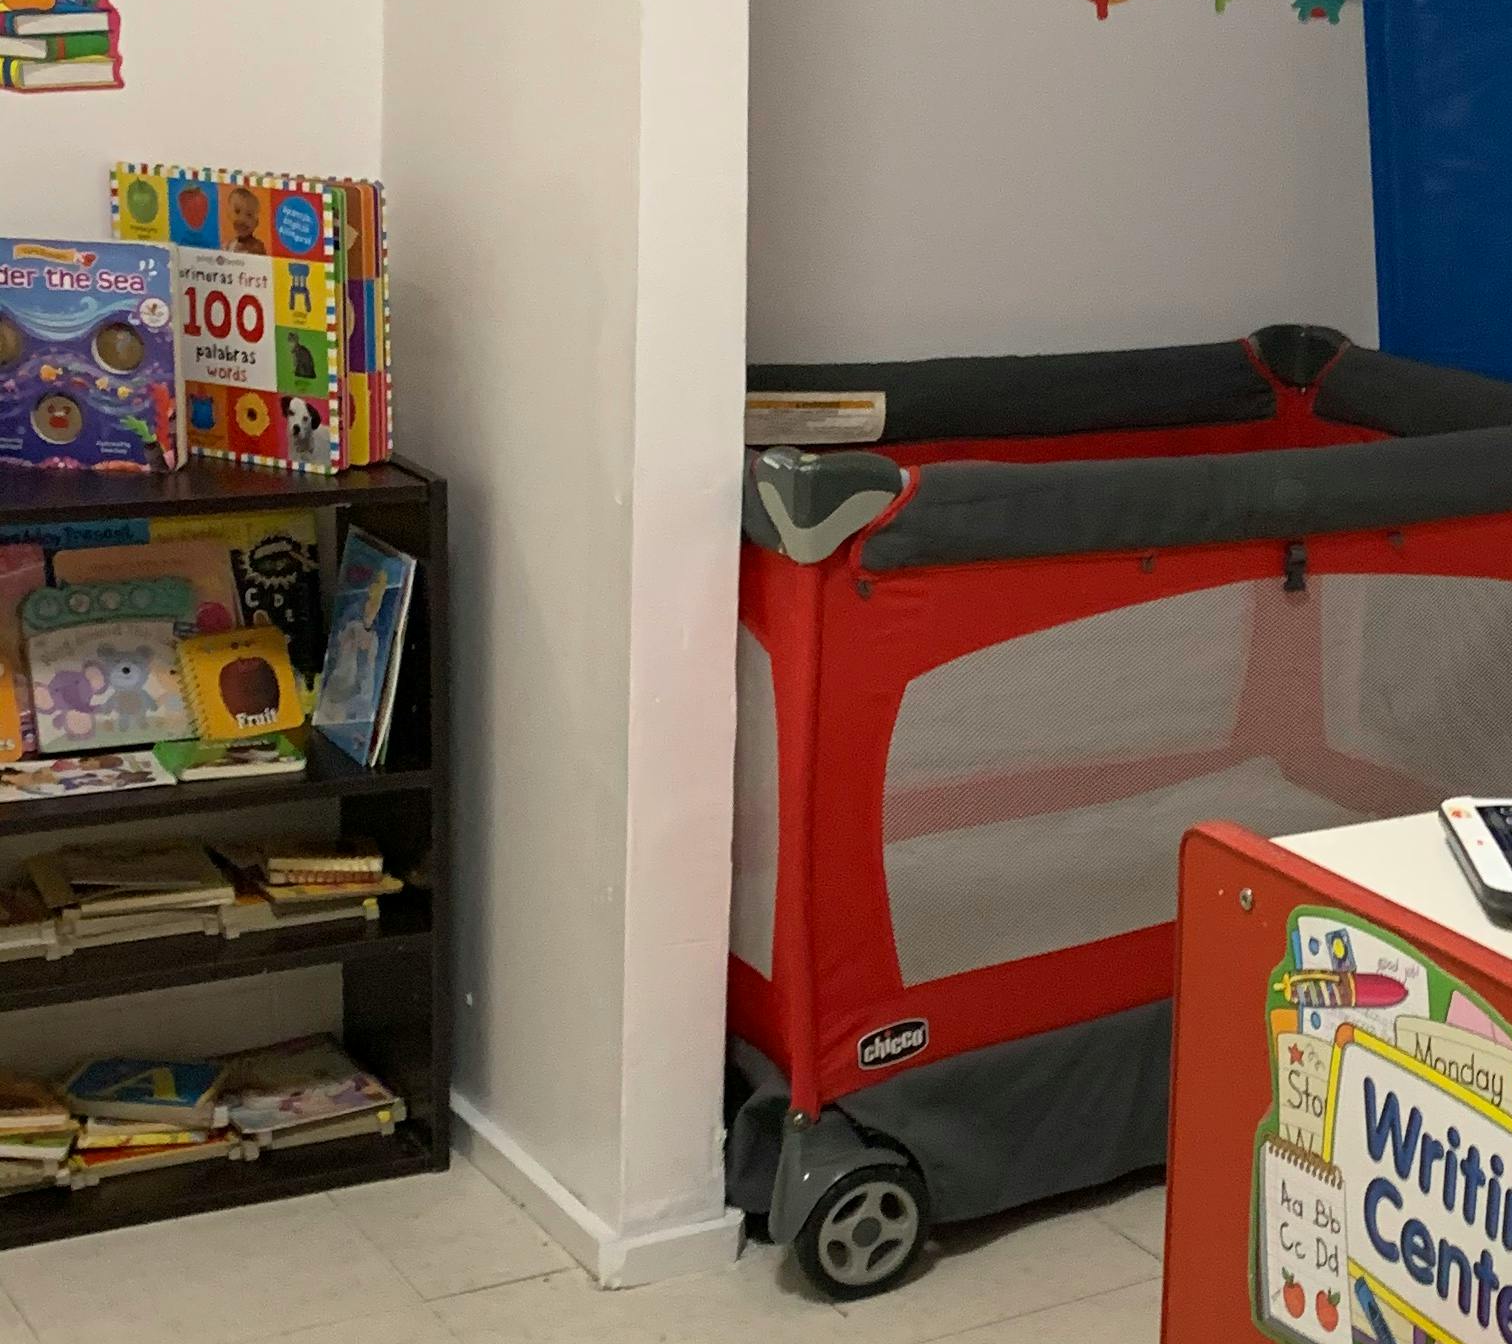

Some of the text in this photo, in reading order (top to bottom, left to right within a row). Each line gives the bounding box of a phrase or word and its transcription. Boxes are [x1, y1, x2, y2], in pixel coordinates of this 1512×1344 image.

[44, 268, 91, 289] the
[97, 270, 146, 292] Sea
[239, 271, 268, 288] first
[183, 286, 265, 344] 100
[195, 343, 257, 365] palabras
[206, 366, 248, 382] words
[235, 707, 278, 729] Fruit
[863, 1028, 924, 1063] chicco
[1414, 1032, 1504, 1108] Monday
[1287, 1069, 1330, 1118] Sto
[1281, 1180, 1341, 1235] Aa Bb
[1280, 1221, 1340, 1278] Cc Dd
